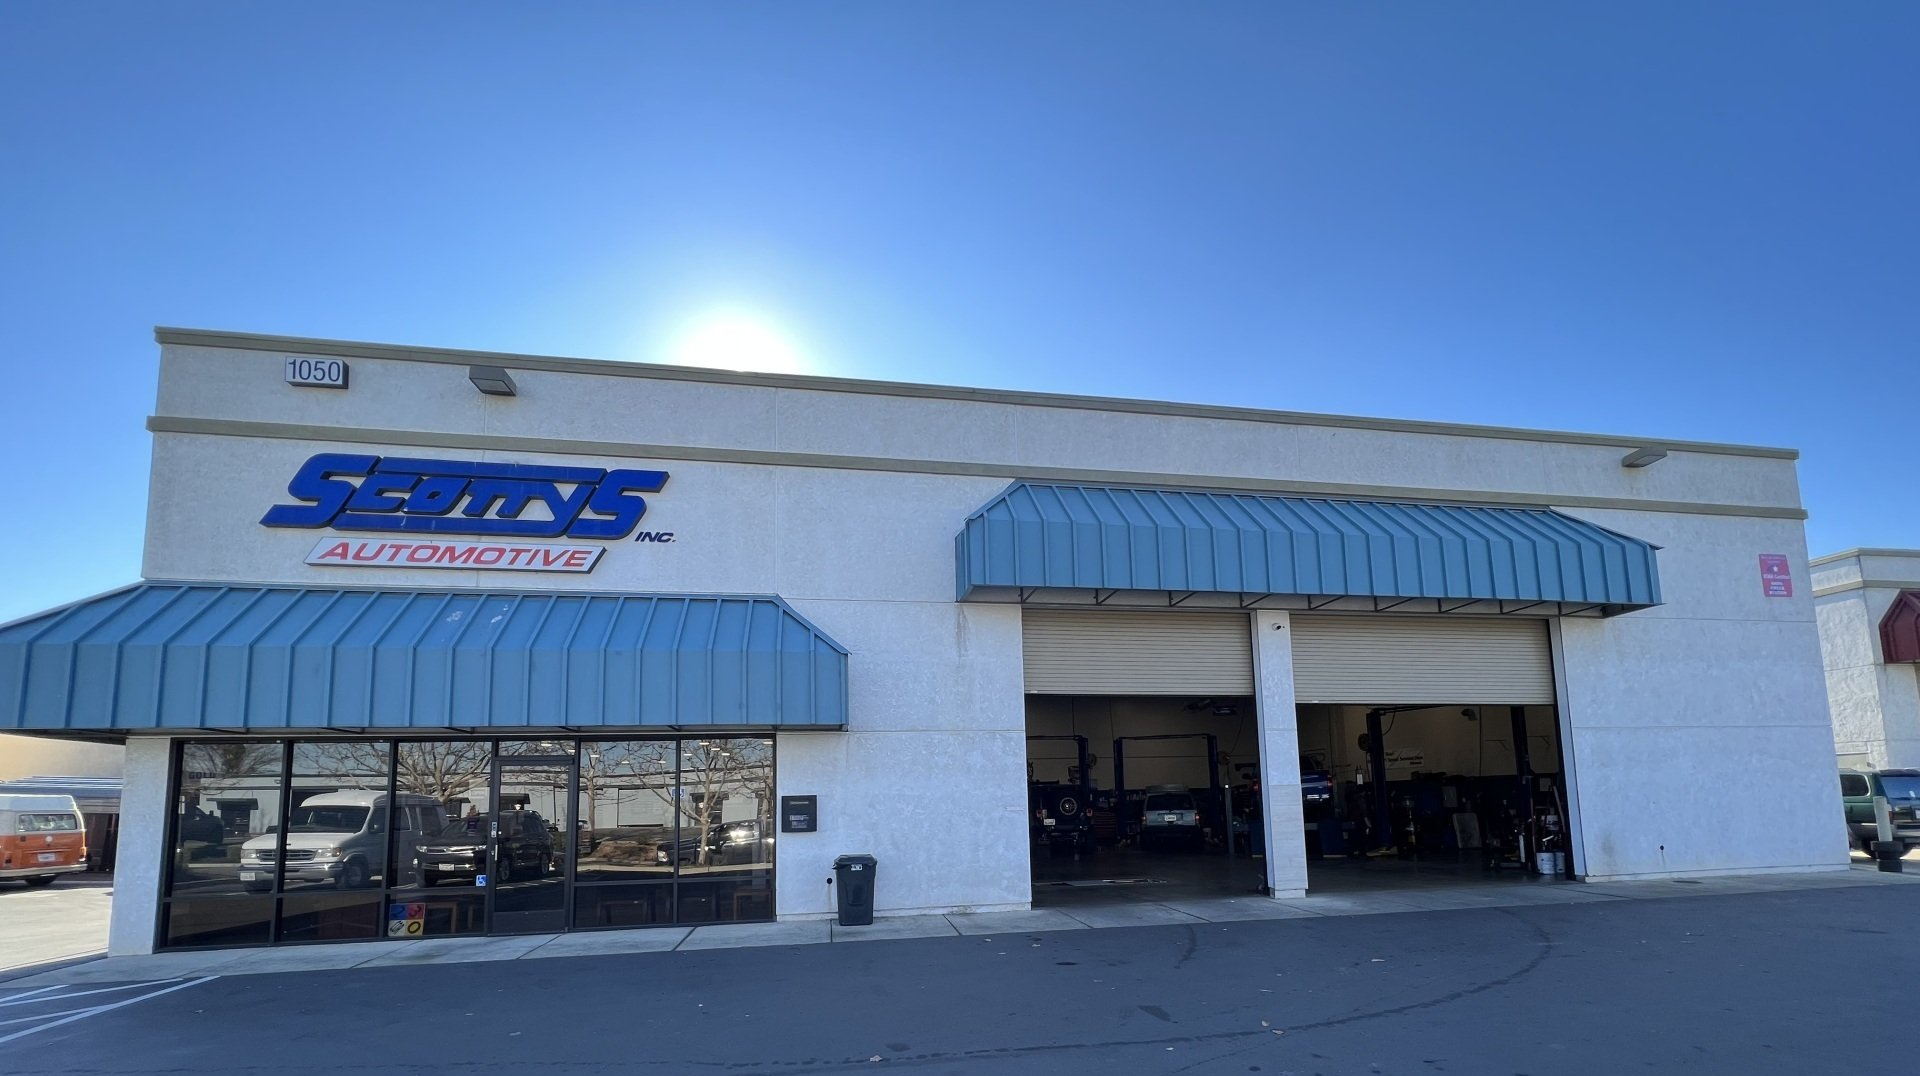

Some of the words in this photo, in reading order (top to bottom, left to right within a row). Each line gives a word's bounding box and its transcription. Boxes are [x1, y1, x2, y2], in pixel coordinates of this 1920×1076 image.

[288, 359, 341, 382] 1050
[634, 531, 677, 543] INC.
[317, 542, 593, 568] AUTOMOTIVE
